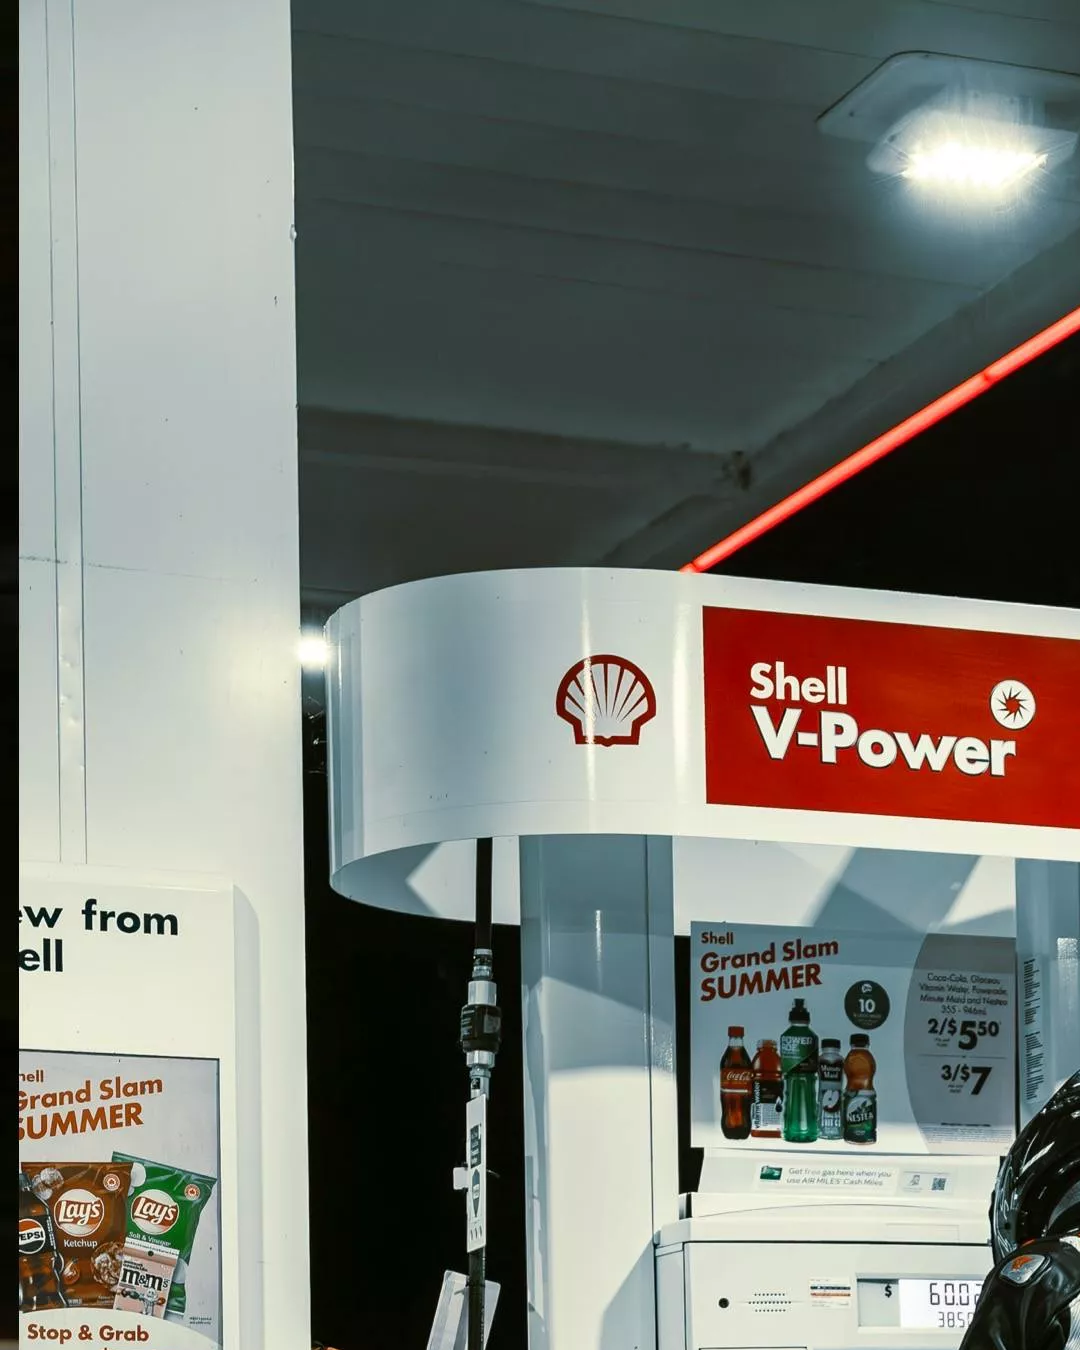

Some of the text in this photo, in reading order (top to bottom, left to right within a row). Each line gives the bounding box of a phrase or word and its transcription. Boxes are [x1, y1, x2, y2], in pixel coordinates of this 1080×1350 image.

[750, 661, 848, 706] Shell
[750, 706, 1017, 777] V-Power
[19, 898, 178, 936] w from
[701, 931, 734, 945] Shell
[700, 938, 838, 973] Grand Slam
[700, 963, 823, 1002] SUMMER
[859, 999, 876, 1013] 10
[99, 1076, 163, 1100] Slam
[941, 1063, 993, 1095] 3/$7
[847, 1111, 874, 1122] NESTEA
[58, 1200, 101, 1226] Lay's
[134, 1197, 176, 1225] Lay's
[63, 1239, 98, 1249] Ketchup
[884, 1284, 893, 1298] $
[27, 1323, 150, 1345] Stop & Grab
